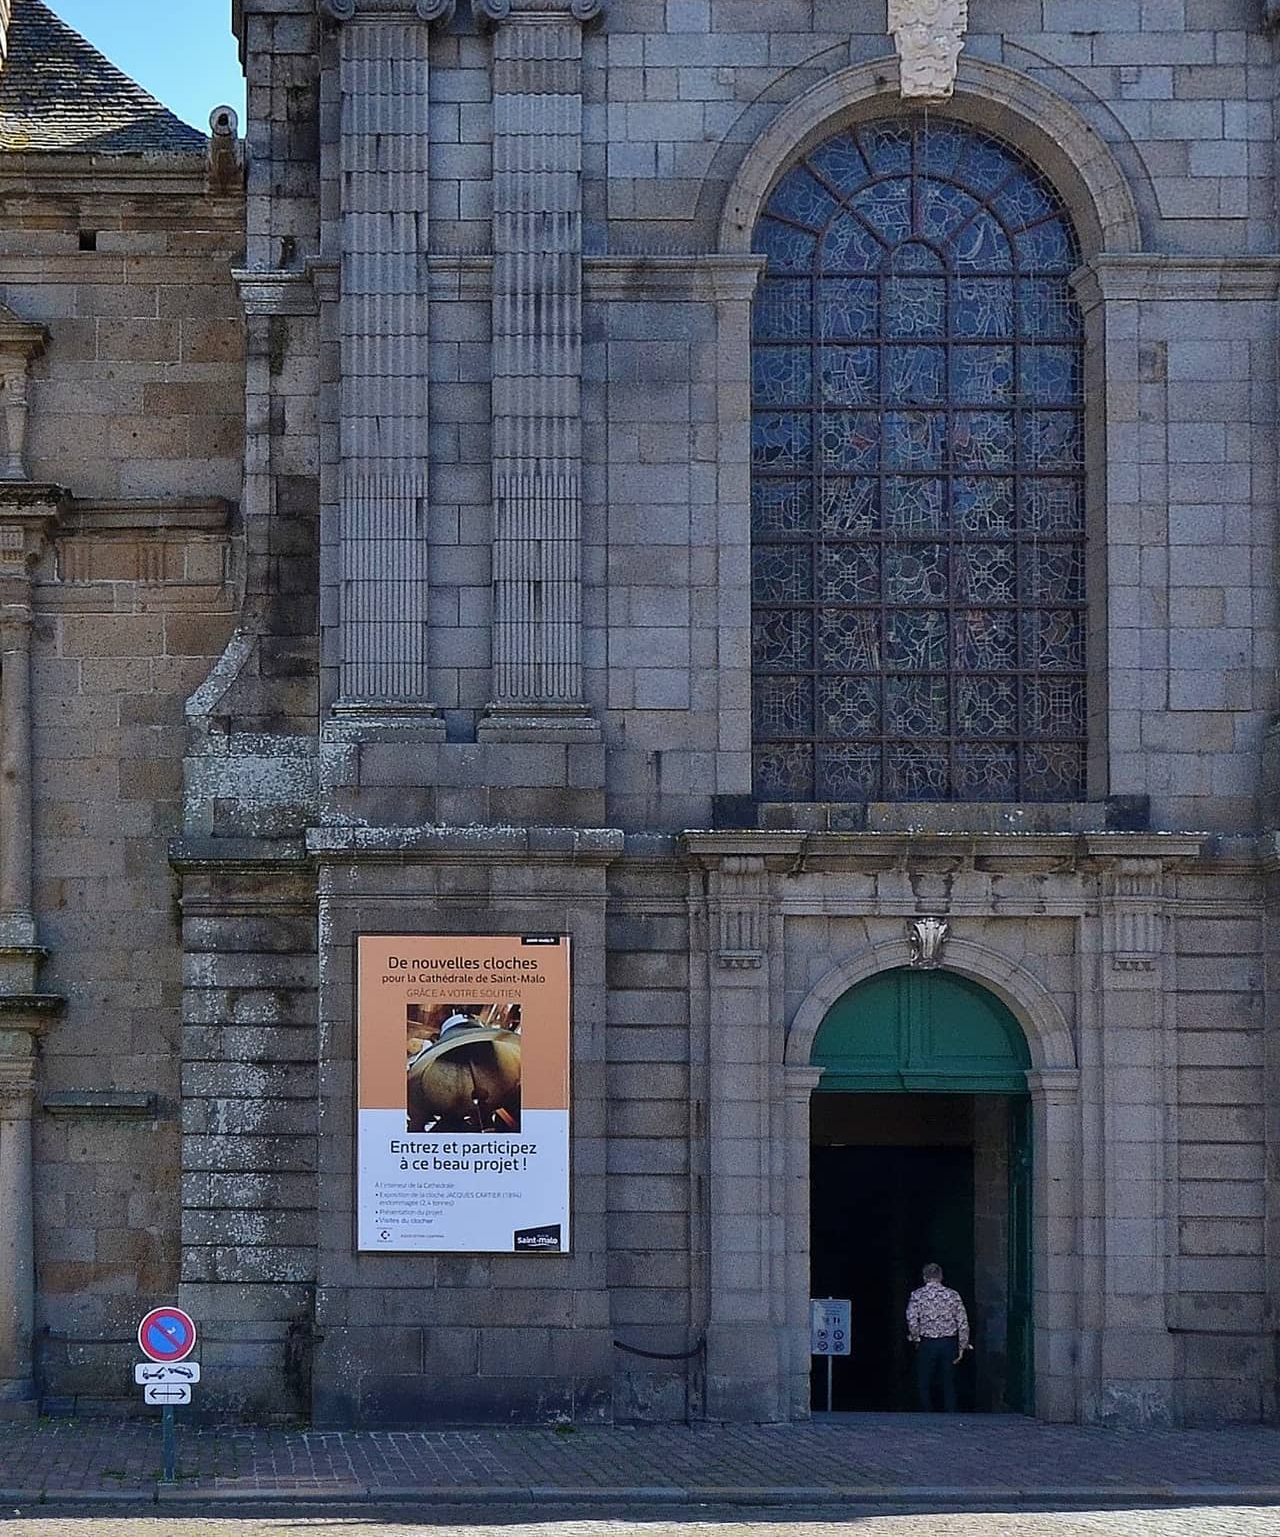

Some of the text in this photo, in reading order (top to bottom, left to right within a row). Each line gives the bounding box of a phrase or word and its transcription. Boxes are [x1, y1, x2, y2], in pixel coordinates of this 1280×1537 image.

[388, 956, 538, 970] De nouvelles cloches
[382, 973, 546, 984] pour la Cathédrale de Saint-Malo
[406, 987, 438, 998] GRÂCE
[447, 989, 478, 998] VOTRE
[480, 989, 521, 998] SOUTIEN
[390, 1140, 537, 1157] Entrez et participez
[400, 1157, 408, 1171] à
[412, 1159, 429, 1171] ce
[433, 1157, 469, 1171] beau
[474, 1157, 519, 1173] projet
